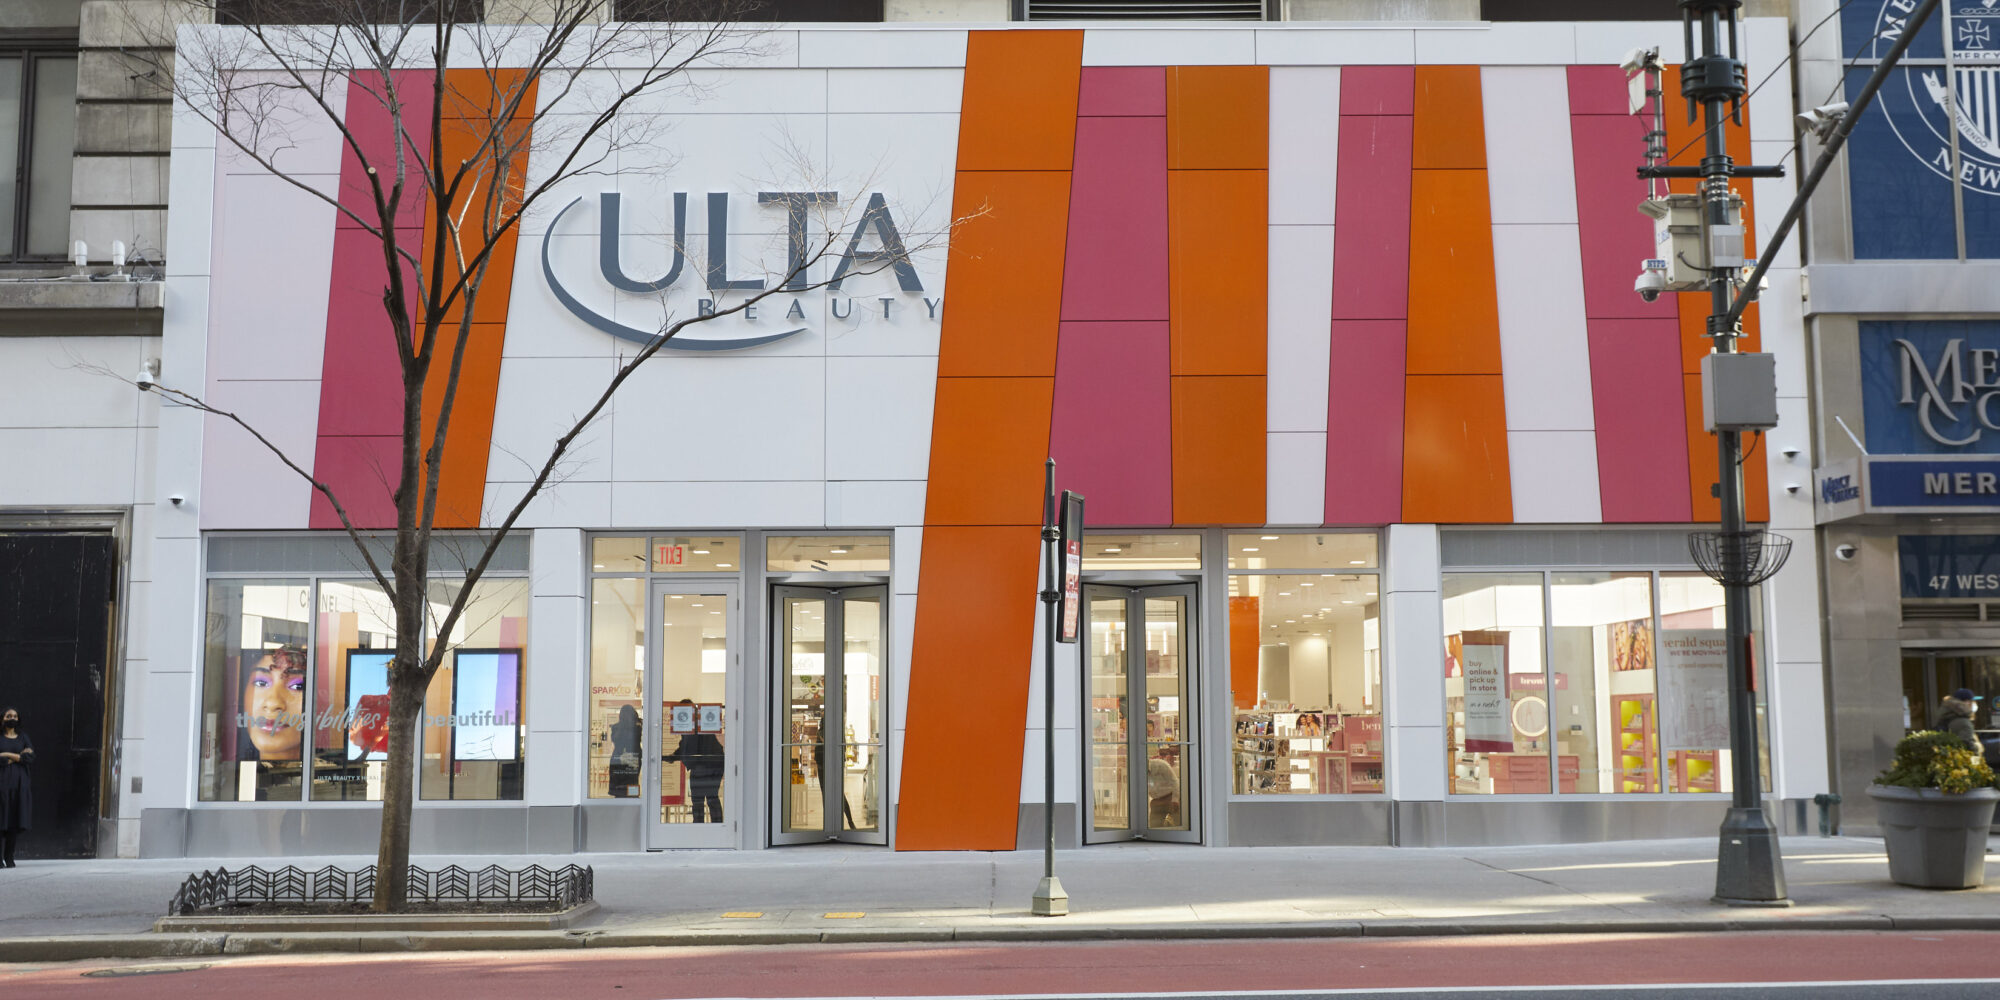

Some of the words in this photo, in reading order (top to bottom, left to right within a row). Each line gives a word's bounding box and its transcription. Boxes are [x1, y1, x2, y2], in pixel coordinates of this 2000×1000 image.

[600, 192, 924, 293] ULTA
[699, 298, 940, 319] BEAUTY
[1928, 575, 1950, 590] 47
[1956, 574, 2000, 590] WES
[300, 589, 340, 613] CNEL
[1699, 639, 1726, 649] squa
[1469, 660, 1482, 668] buy
[1469, 668, 1492, 676] online
[1469, 677, 1485, 685] pick
[592, 684, 631, 695] SPARKED
[235, 711, 267, 729] the
[270, 703, 382, 737] posibilities
